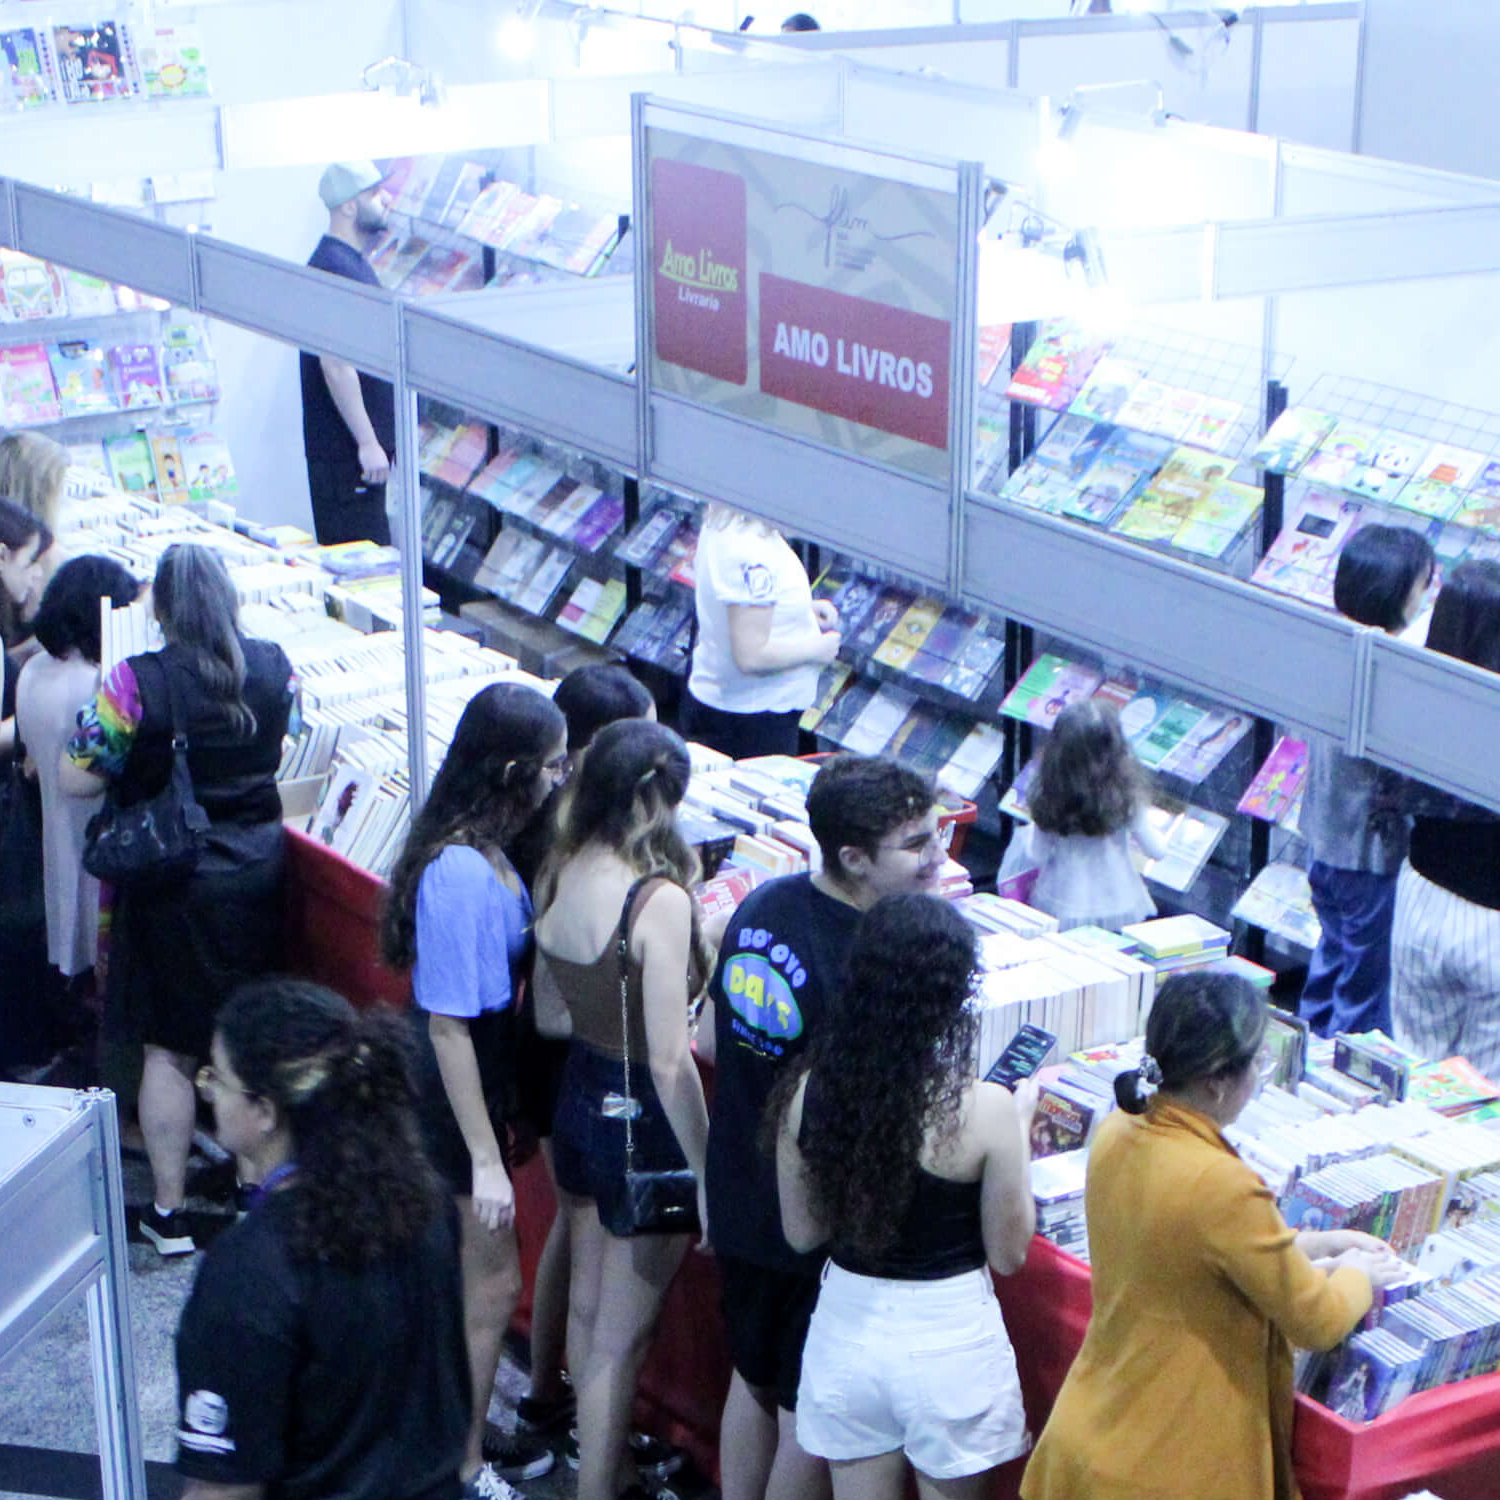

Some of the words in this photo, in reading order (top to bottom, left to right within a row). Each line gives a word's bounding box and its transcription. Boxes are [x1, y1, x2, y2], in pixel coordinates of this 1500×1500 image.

[661, 239, 696, 277] Amo
[699, 248, 739, 288] Livros
[678, 287, 721, 313] Livraria
[773, 321, 829, 367] AMO
[836, 338, 934, 398] LIVROS
[738, 927, 808, 989] BOOVO
